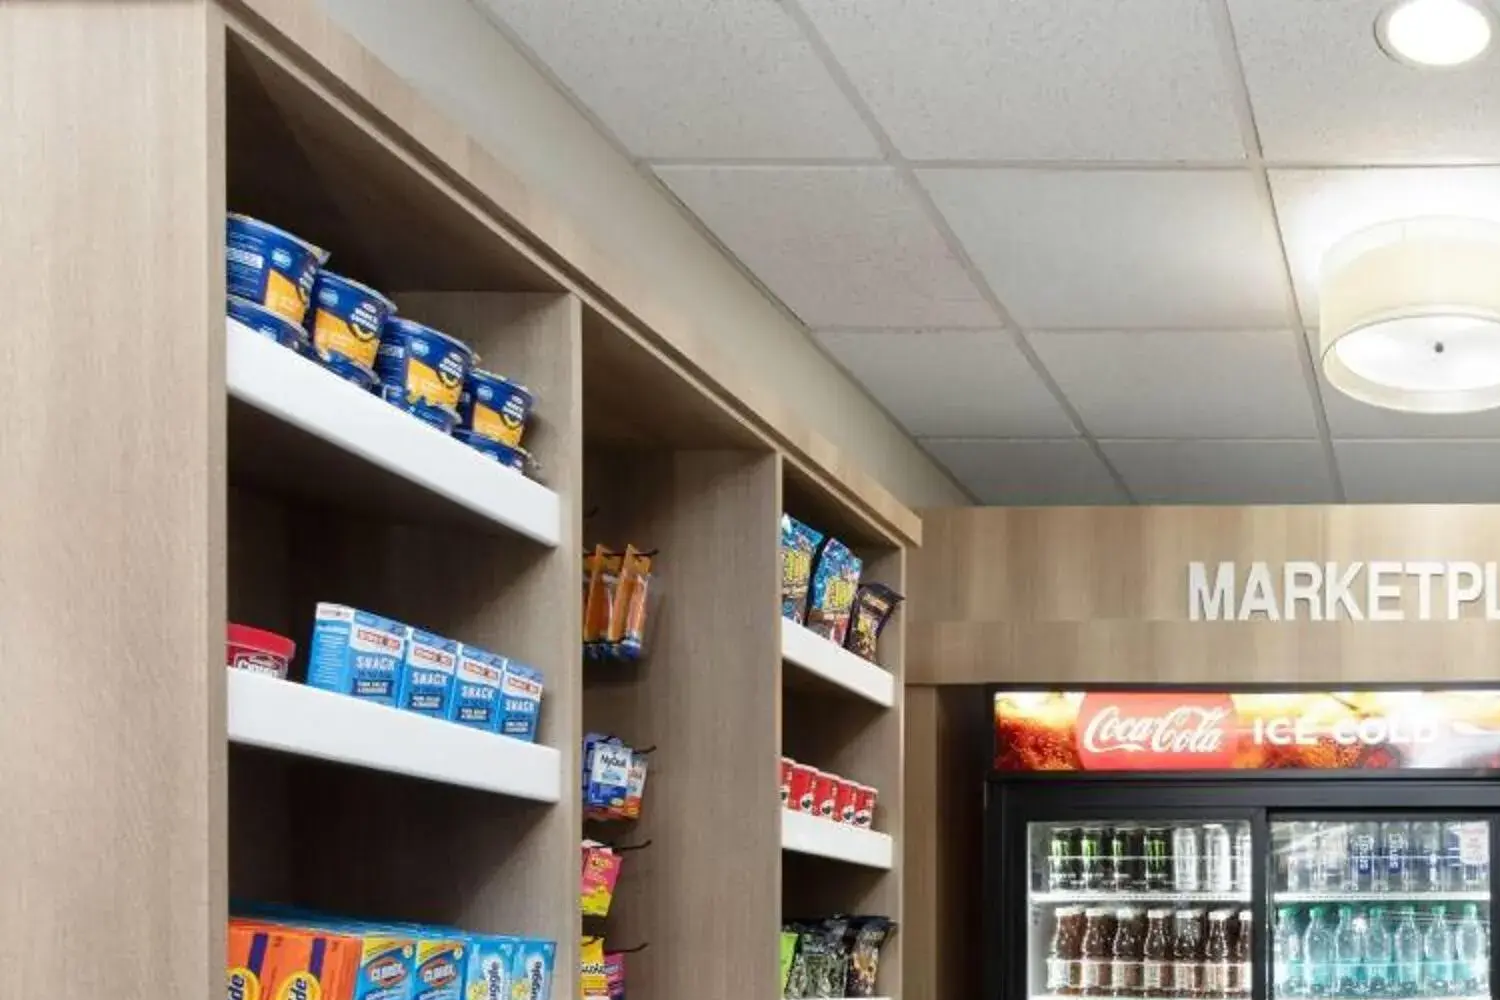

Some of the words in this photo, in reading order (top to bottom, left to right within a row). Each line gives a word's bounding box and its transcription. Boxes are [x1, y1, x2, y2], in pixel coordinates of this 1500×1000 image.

[356, 655, 396, 672] SNACK
[1083, 704, 1228, 754] Coca-Cola
[1253, 724, 1318, 745] ICE
[1332, 718, 1441, 746] COLD
